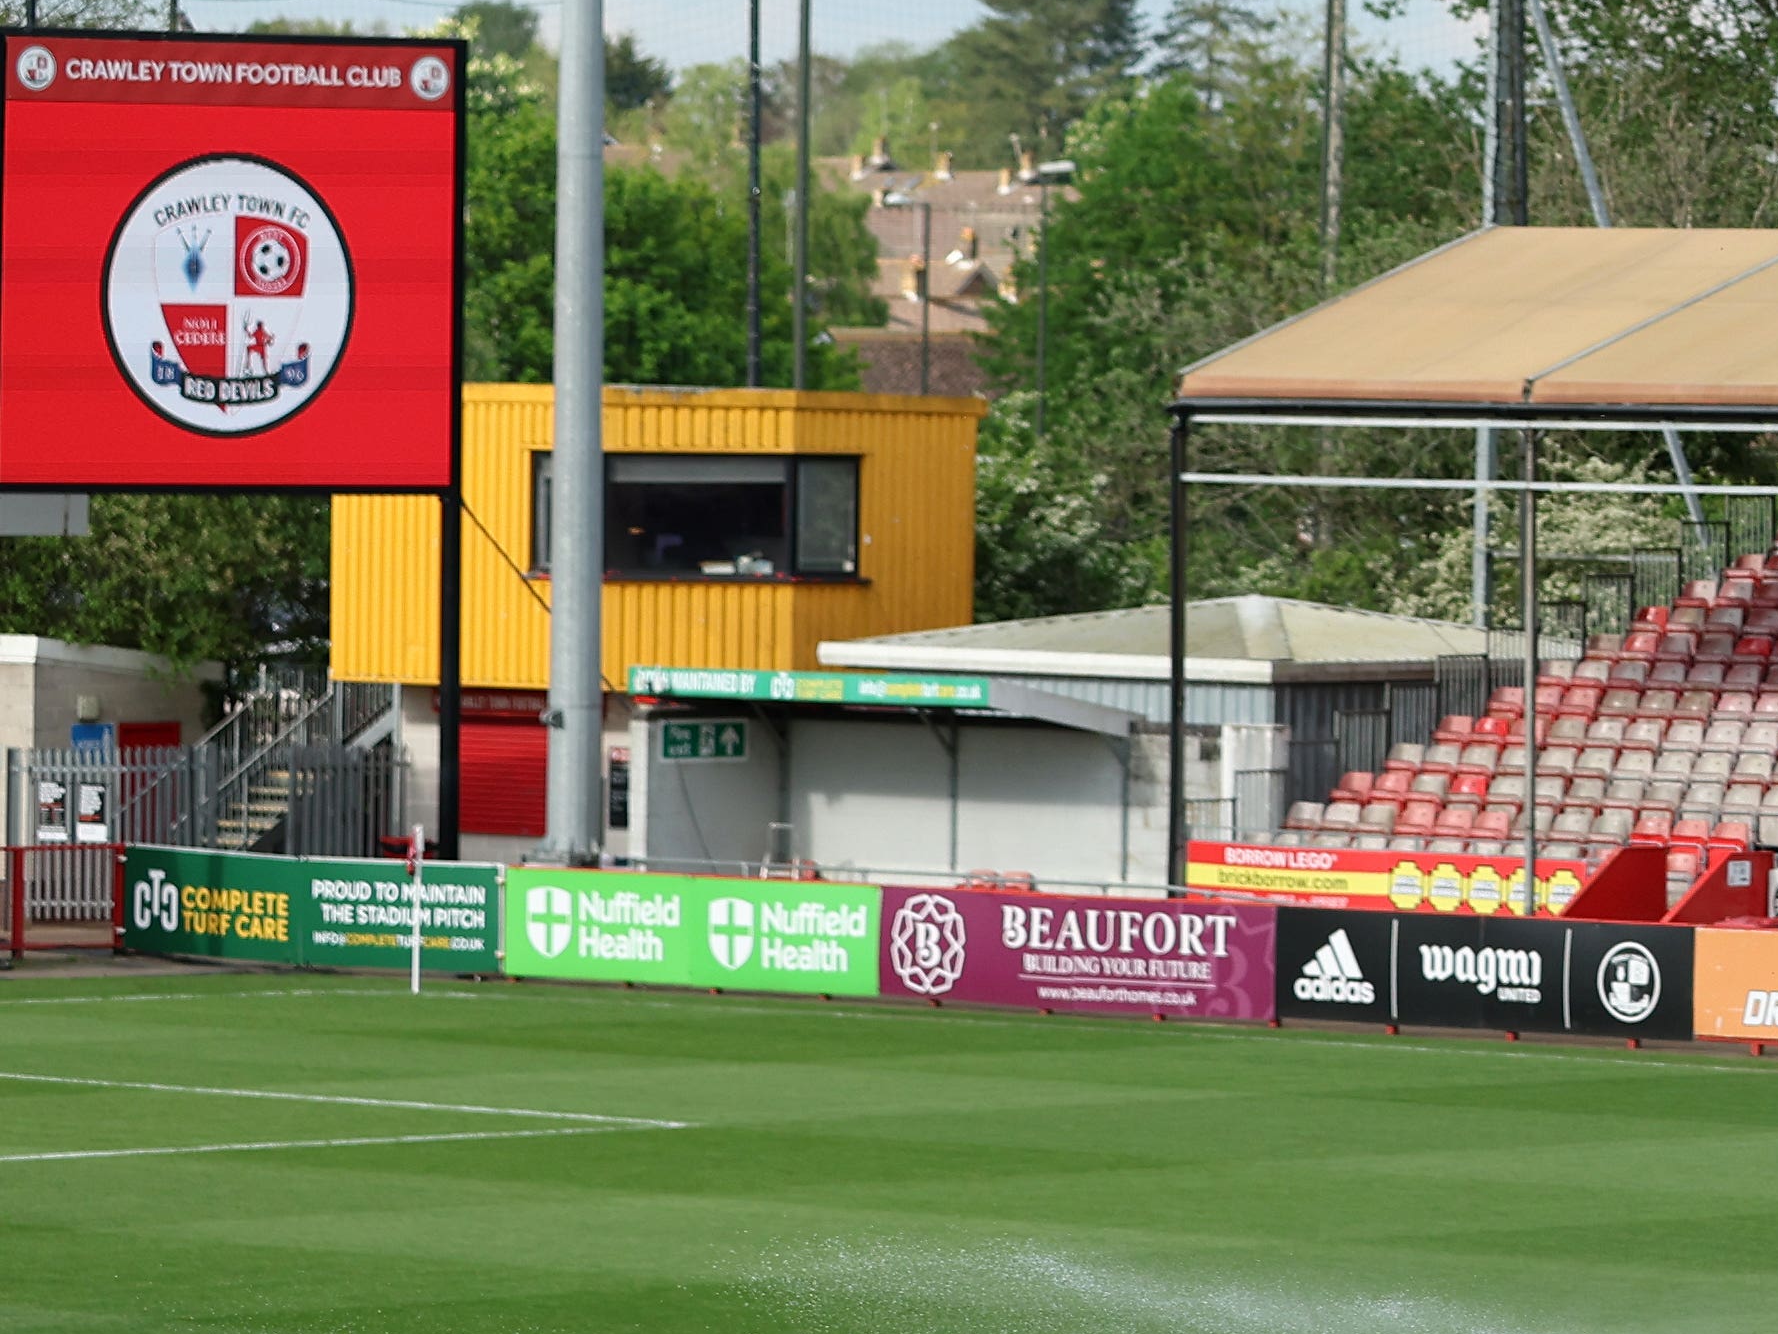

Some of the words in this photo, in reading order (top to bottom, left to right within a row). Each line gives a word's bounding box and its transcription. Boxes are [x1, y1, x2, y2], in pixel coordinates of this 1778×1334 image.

[65, 58, 167, 81] CRAWLEY
[169, 61, 232, 83] TOWN
[235, 63, 345, 87] FOOTBALL
[345, 65, 402, 88] CLUB
[153, 194, 231, 227] CRAWLEY
[237, 194, 287, 216] TOWN
[288, 206, 311, 229] FC
[184, 376, 216, 400] RED
[218, 379, 276, 403] DEVILS
[1223, 846, 1287, 868] BORROW
[311, 879, 372, 901] PROUD
[373, 881, 399, 902] TO
[401, 882, 486, 905] MAINTAIN
[1217, 868, 1349, 891] brickborrow.com
[181, 885, 289, 917] COMPLETE
[320, 902, 355, 924] THE
[356, 904, 432, 927] STADIUM
[433, 907, 486, 930] PITCH
[578, 890, 681, 927] Nuffield
[182, 910, 233, 937] TURF
[234, 914, 289, 942] CARE
[761, 901, 868, 938] Nuffield
[1001, 904, 1237, 958] BEAUFORT
[578, 925, 664, 961] Health
[761, 937, 848, 972] Health
[1022, 952, 1100, 977] BUILDING
[1099, 956, 1151, 978] YOUR
[1151, 958, 1212, 981] FUTURE
[1419, 942, 1542, 995] wagmi
[1036, 984, 1197, 1007] www.beauforthomes.co.uk
[1294, 975, 1376, 1005] adidas
[1498, 987, 1542, 1004] UNITED
